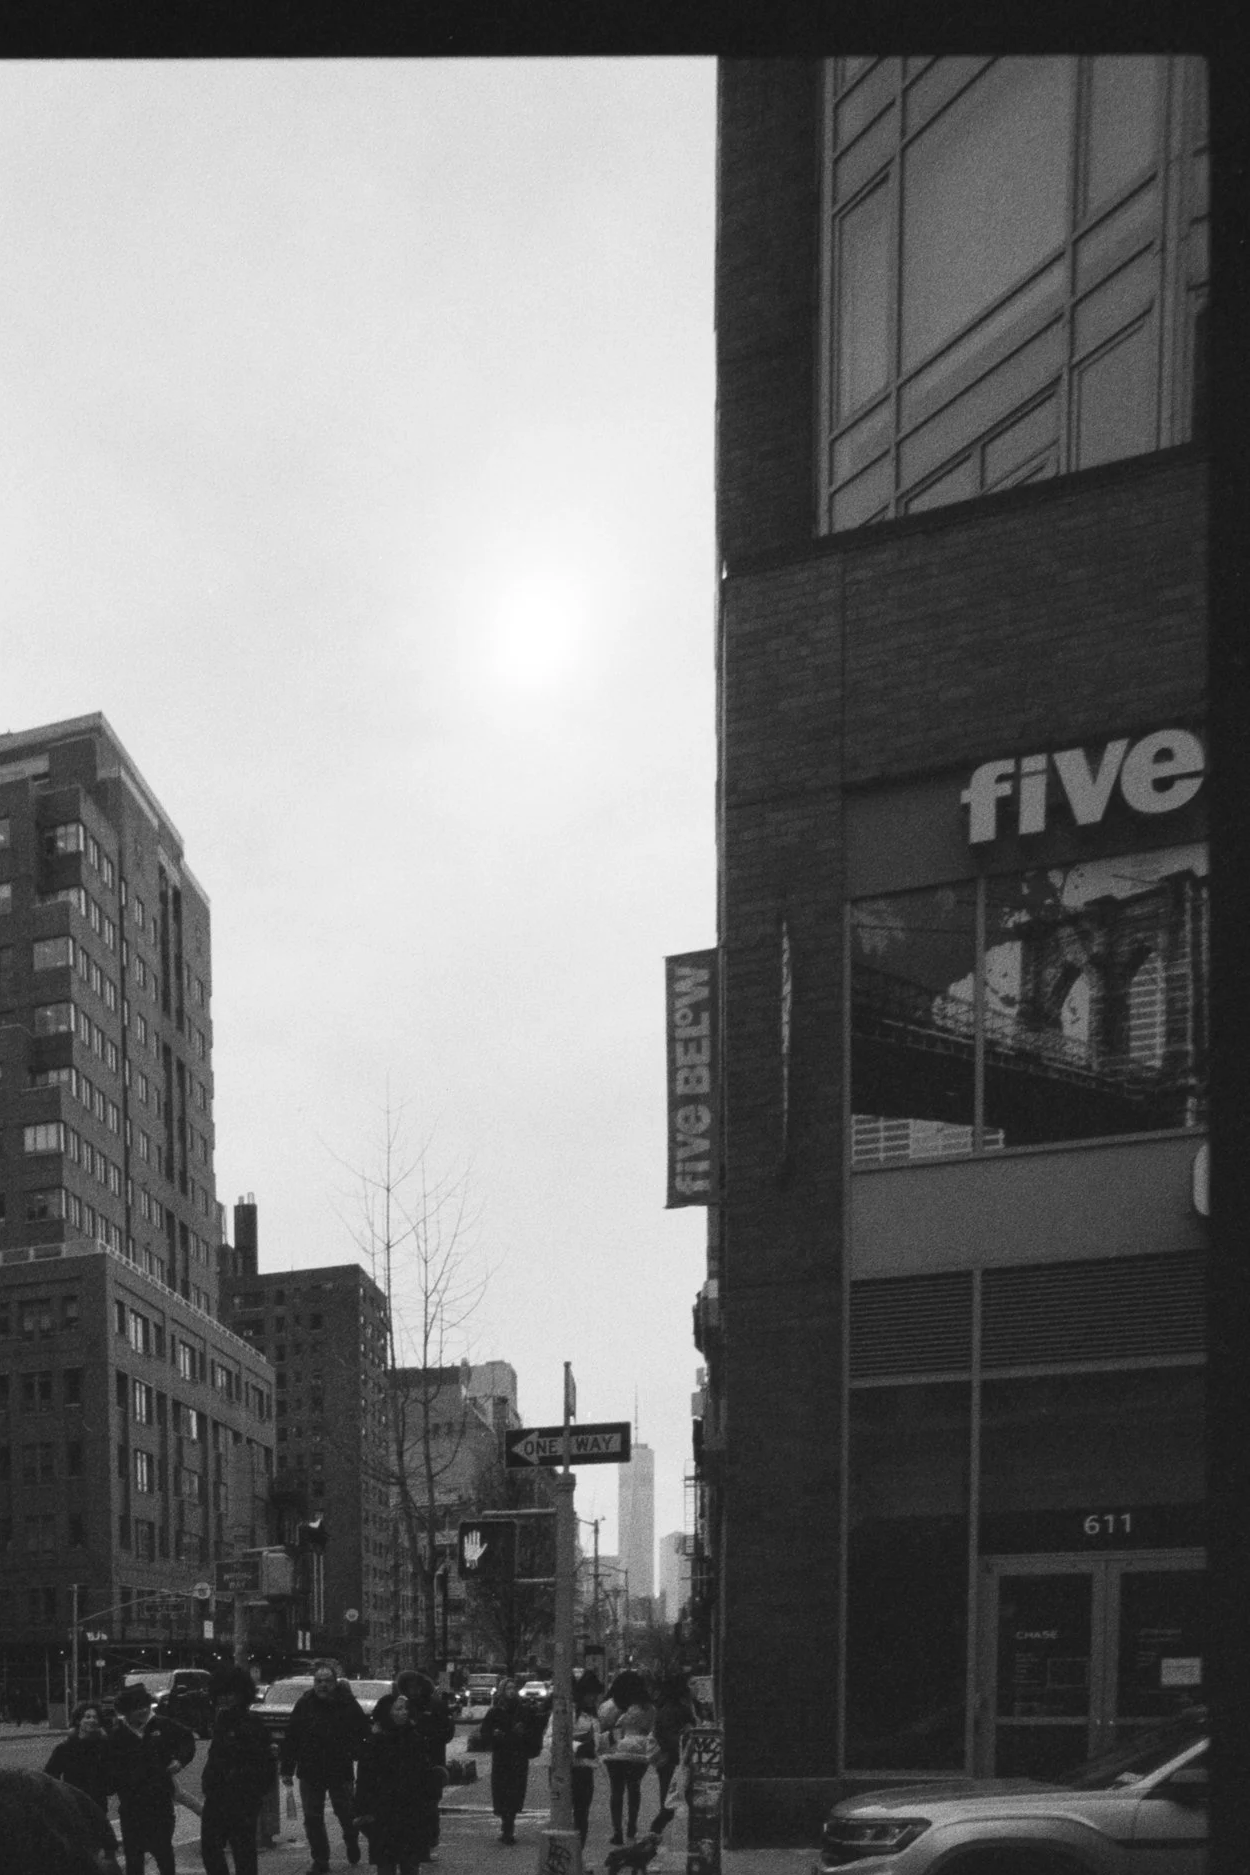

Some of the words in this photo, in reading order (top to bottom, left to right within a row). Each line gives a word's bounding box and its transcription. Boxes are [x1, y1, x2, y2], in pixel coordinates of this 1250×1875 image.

[961, 728, 1205, 846] five
[674, 1104, 712, 1195] five
[523, 1440, 558, 1457] ONE
[575, 1435, 614, 1454] WAY
[1084, 1513, 1131, 1535] 611
[1015, 1629, 1058, 1640] CHASE
